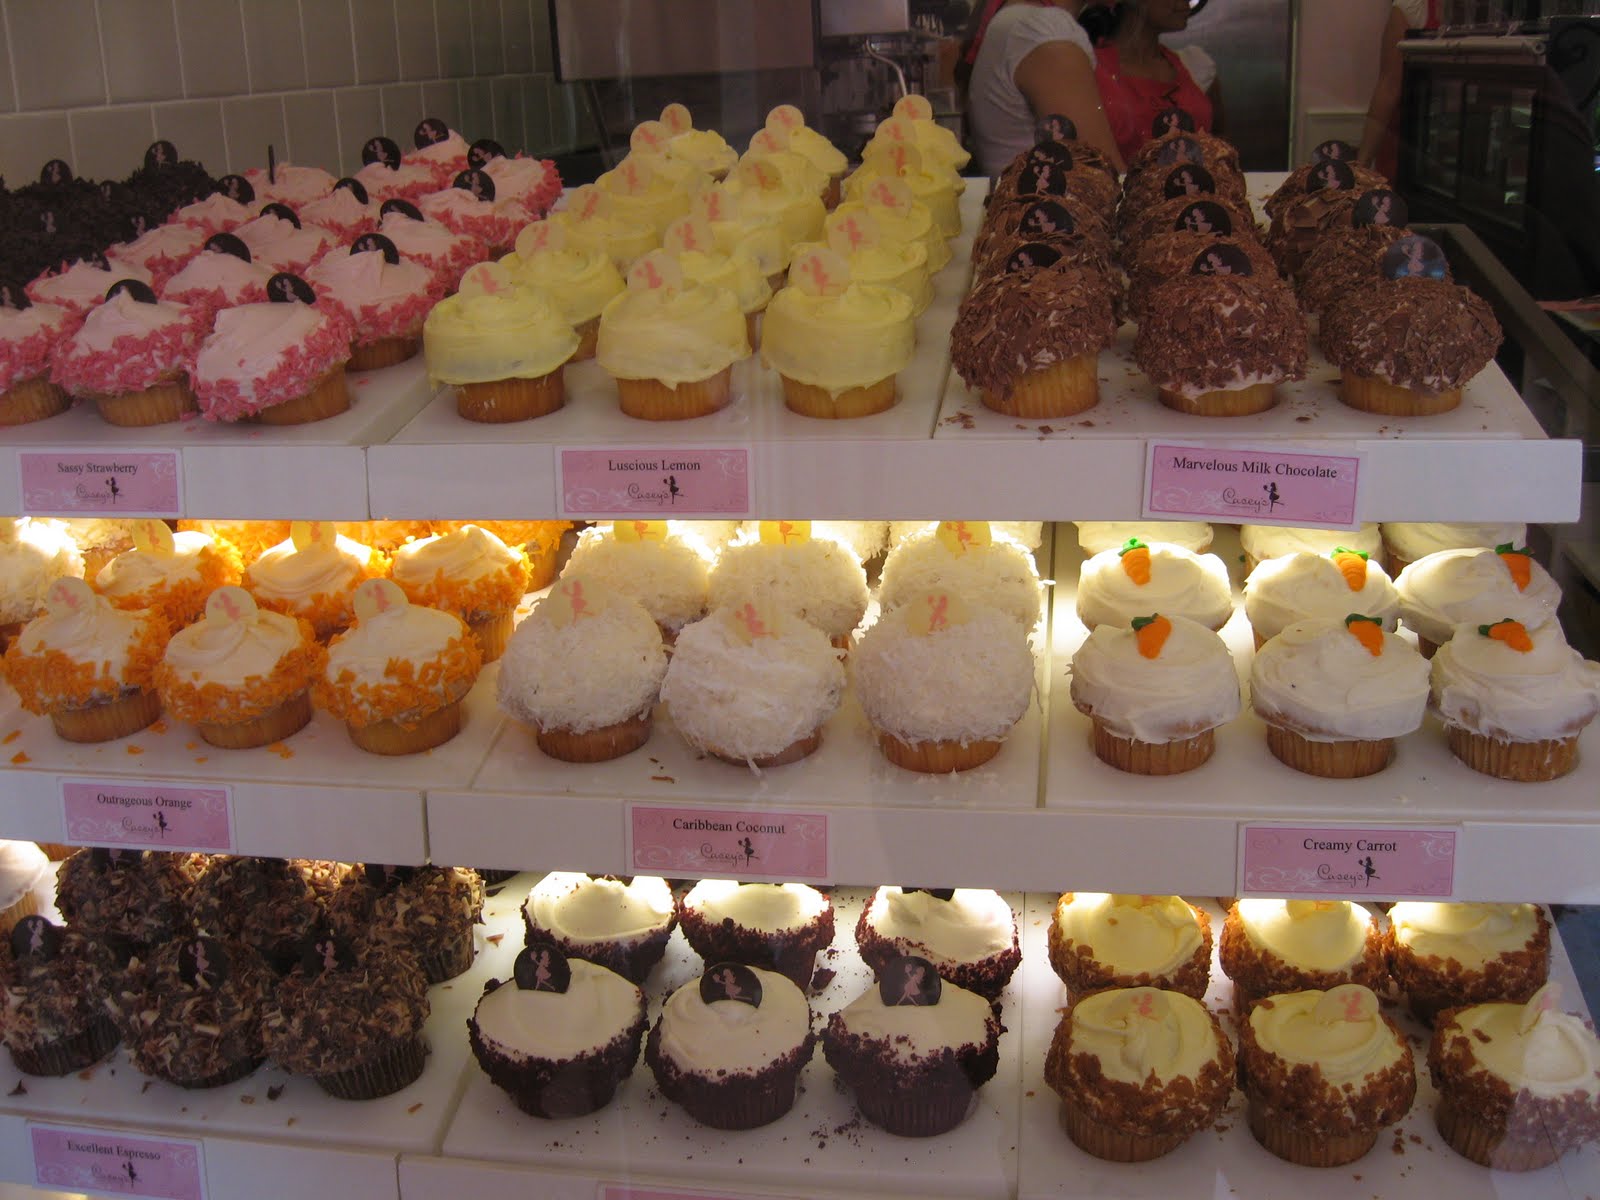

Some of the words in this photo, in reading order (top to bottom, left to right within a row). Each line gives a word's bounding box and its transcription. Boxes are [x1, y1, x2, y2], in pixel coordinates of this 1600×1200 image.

[57, 462, 84, 475] Sassy
[86, 462, 139, 475] Strawberry
[608, 459, 658, 471] Luscious
[661, 459, 701, 471] Lemon
[1172, 457, 1238, 473] Marvelous
[1242, 460, 1271, 474] Milk
[1275, 463, 1338, 479] Chocolate
[627, 482, 669, 505] Casey's
[1222, 487, 1270, 512] Casey's
[96, 793, 153, 808] Outrageous
[155, 796, 193, 810] Orange
[672, 818, 732, 832] Caribbean
[735, 821, 786, 834] Coconut
[700, 842, 745, 867] Casey's
[1303, 838, 1353, 853] Creamy
[1356, 839, 1398, 852] Carrot
[1317, 863, 1365, 888] Casey's
[67, 1140, 113, 1155] Excellent
[116, 1145, 161, 1161] Espresso
